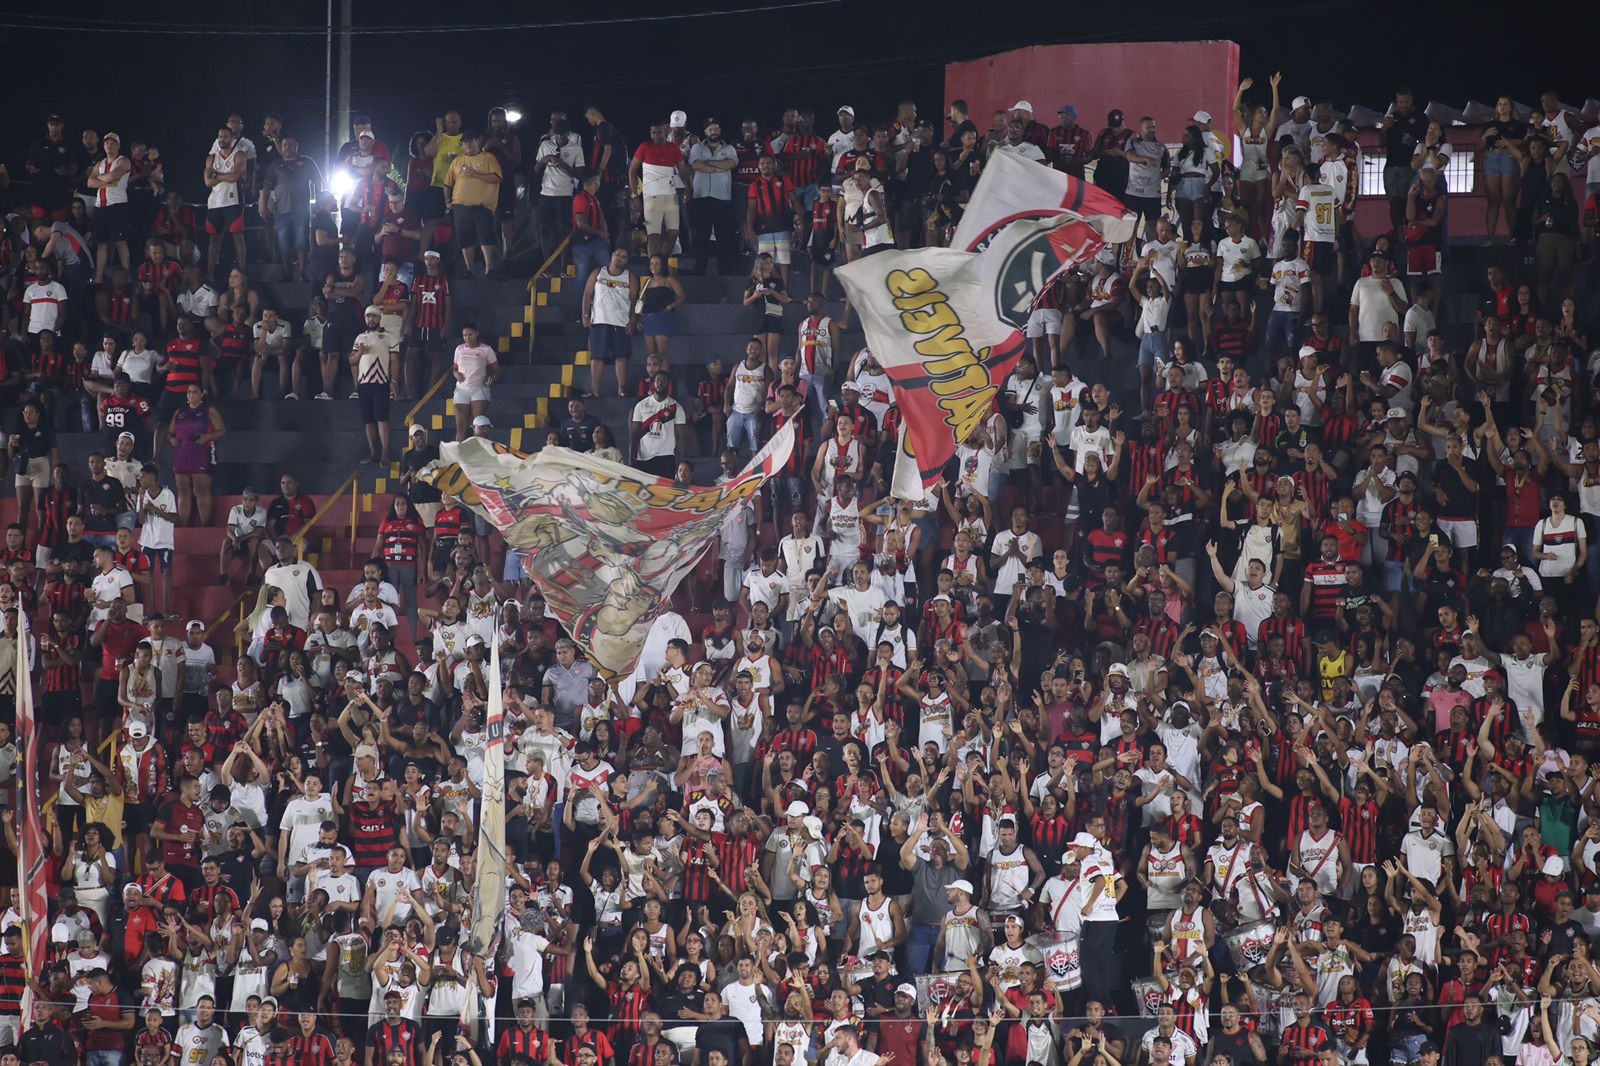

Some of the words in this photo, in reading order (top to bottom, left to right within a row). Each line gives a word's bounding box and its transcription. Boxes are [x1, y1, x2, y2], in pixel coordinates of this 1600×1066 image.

[1315, 202, 1332, 224] 97
[105, 413, 125, 428] 99
[1576, 721, 1600, 730] CAIX
[188, 1047, 208, 1065] 97
